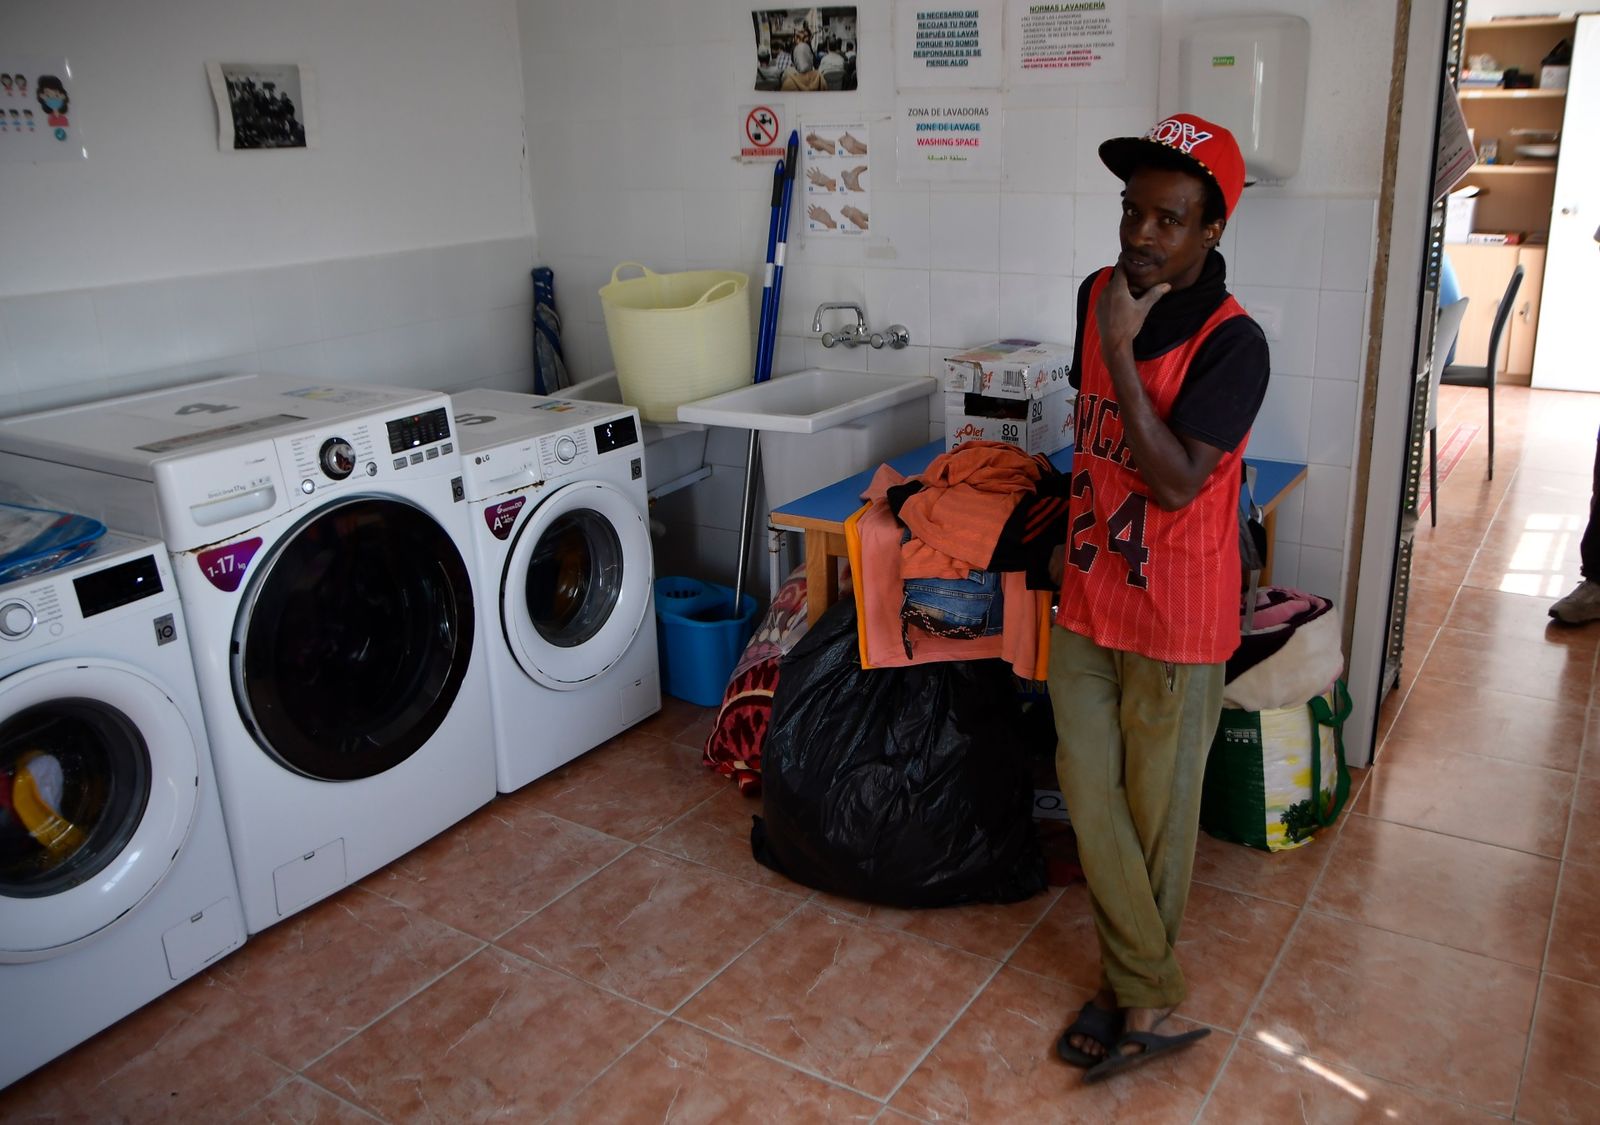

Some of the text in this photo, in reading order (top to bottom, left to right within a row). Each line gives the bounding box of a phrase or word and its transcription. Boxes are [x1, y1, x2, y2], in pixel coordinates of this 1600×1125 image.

[1030, 2, 1105, 14] NORMAS LAVANDERÍA
[927, 11, 964, 19] NECESARIO
[965, 10, 978, 18] QUE
[913, 50, 964, 58] RESPONSABLES
[908, 107, 989, 116] ZONA DE LAVADORAS
[951, 123, 980, 131] LAVAGE
[917, 138, 953, 146] WASHING
[1032, 401, 1042, 418] 80
[1002, 424, 1018, 437] 80
[1067, 469, 1150, 590] 24
[208, 554, 234, 578] 1-17
